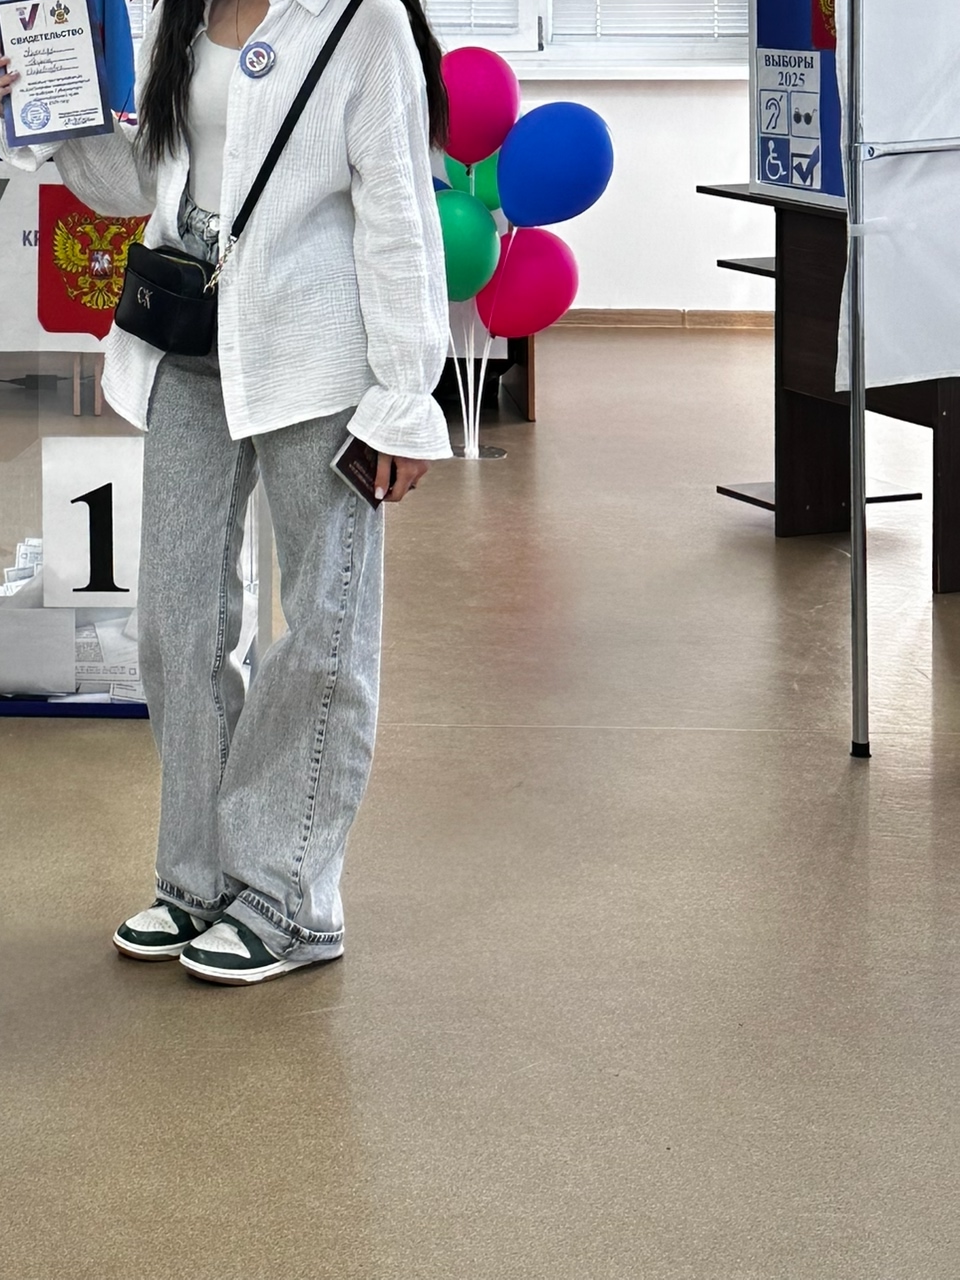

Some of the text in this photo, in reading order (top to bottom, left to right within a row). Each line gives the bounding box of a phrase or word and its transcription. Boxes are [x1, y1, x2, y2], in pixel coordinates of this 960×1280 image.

[10, 27, 84, 46] СВИДЕТЕЛЬСТВО
[764, 54, 814, 69] ВЫБОРЫ
[778, 71, 805, 87] 2025
[70, 482, 130, 592] 1
